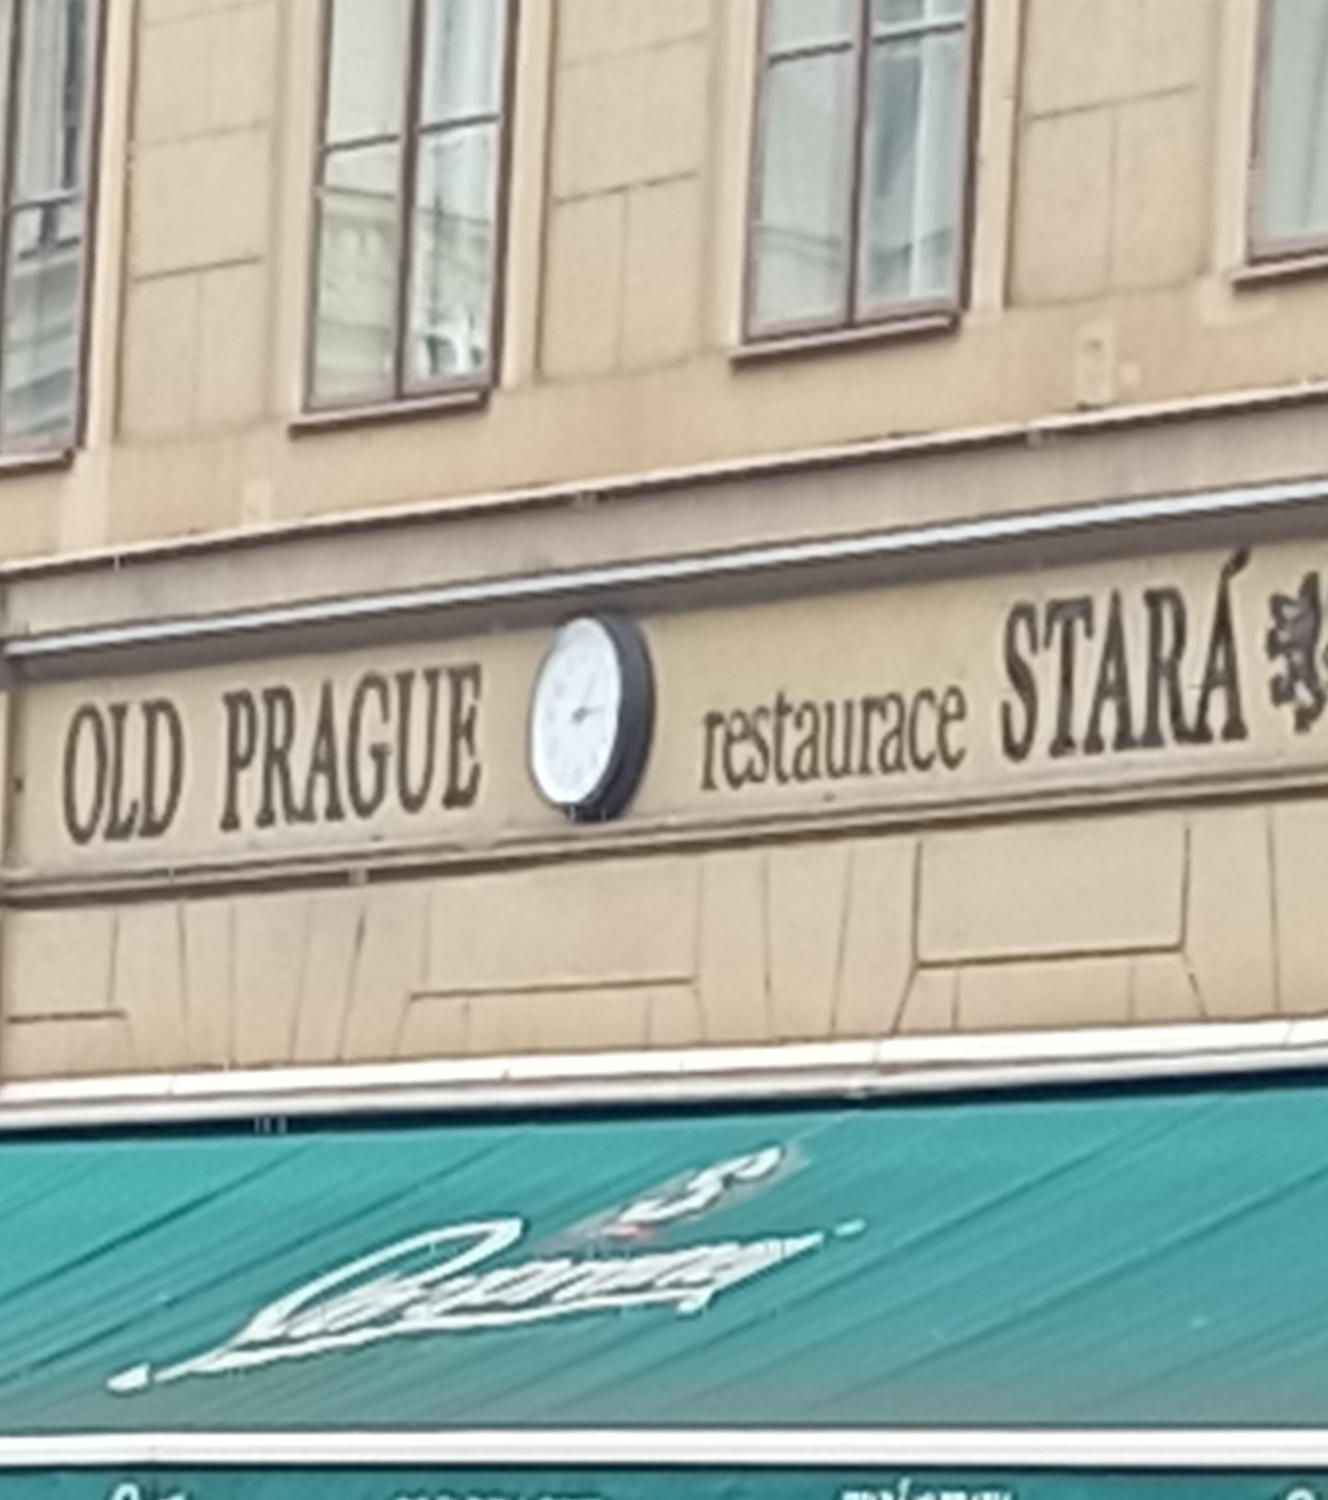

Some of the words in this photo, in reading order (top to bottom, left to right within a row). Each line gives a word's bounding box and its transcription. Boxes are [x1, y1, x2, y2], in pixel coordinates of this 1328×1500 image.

[63, 697, 184, 845] OLD
[219, 663, 482, 832] PRAGUE
[700, 683, 968, 791] restaurace
[1001, 548, 1248, 763] STARÁ
